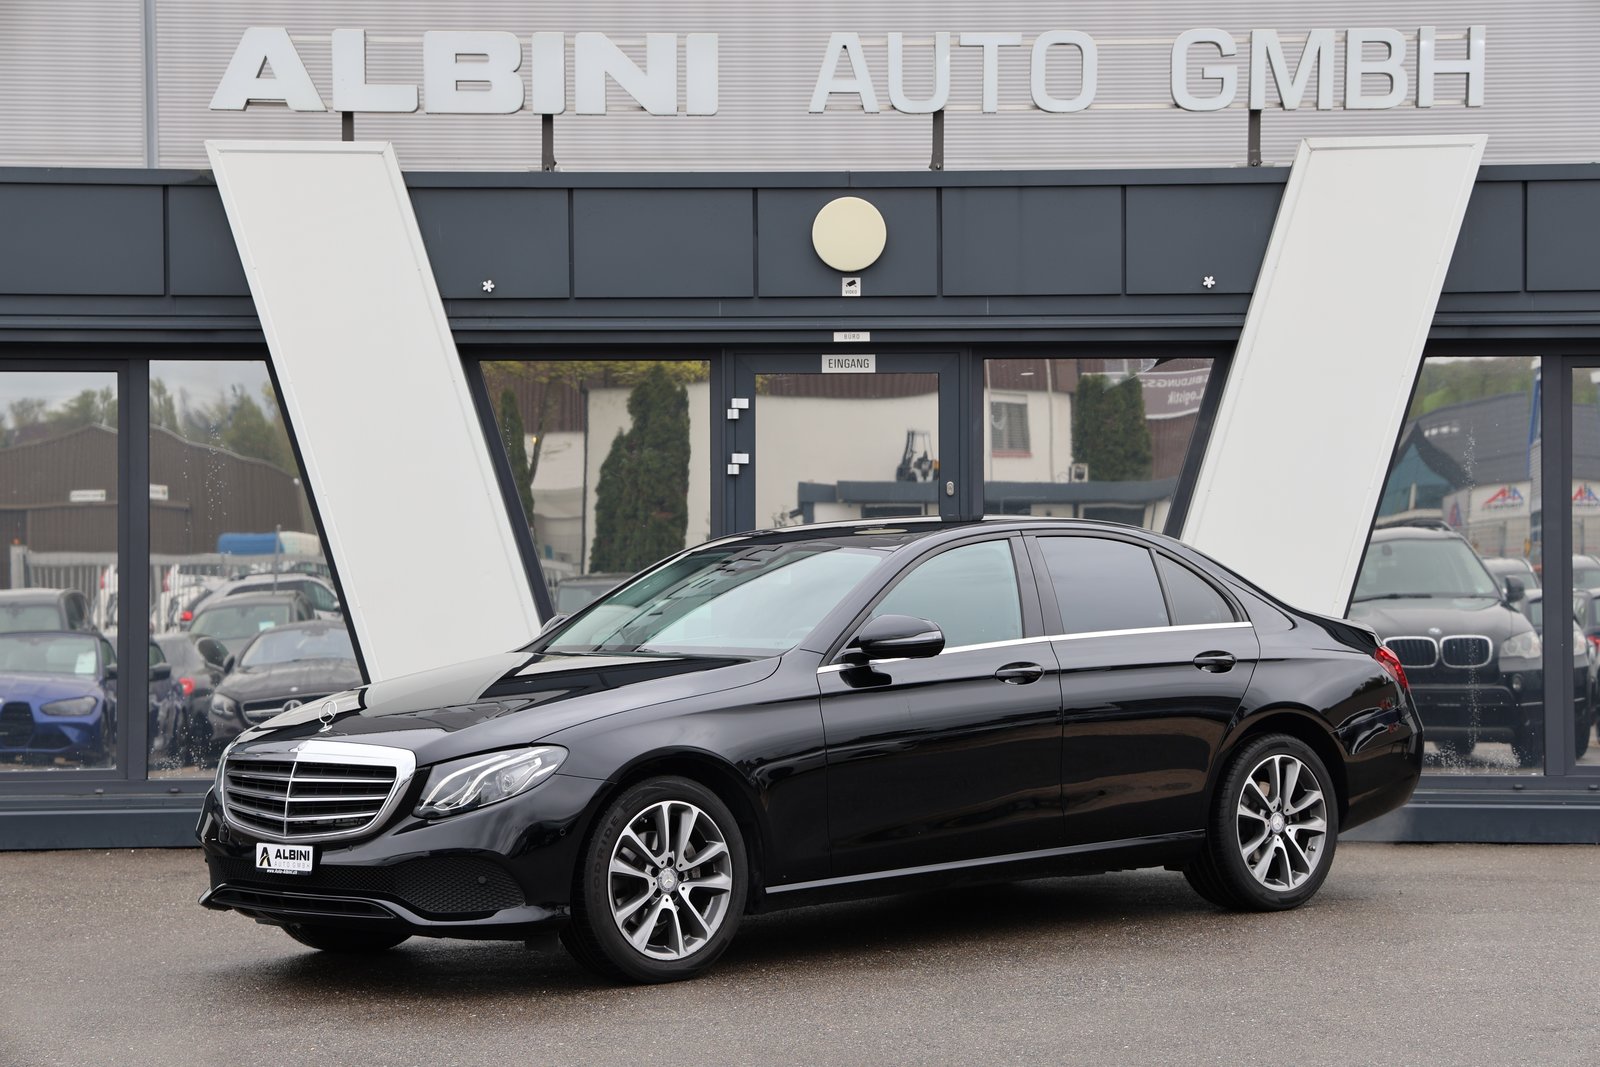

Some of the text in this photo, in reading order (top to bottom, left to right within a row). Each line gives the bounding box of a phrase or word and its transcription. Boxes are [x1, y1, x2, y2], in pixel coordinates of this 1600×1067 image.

[208, 25, 1486, 116] ALBINI AUTO GMBH
[828, 358, 870, 369] EINGANG
[274, 849, 310, 861] ALBINI
